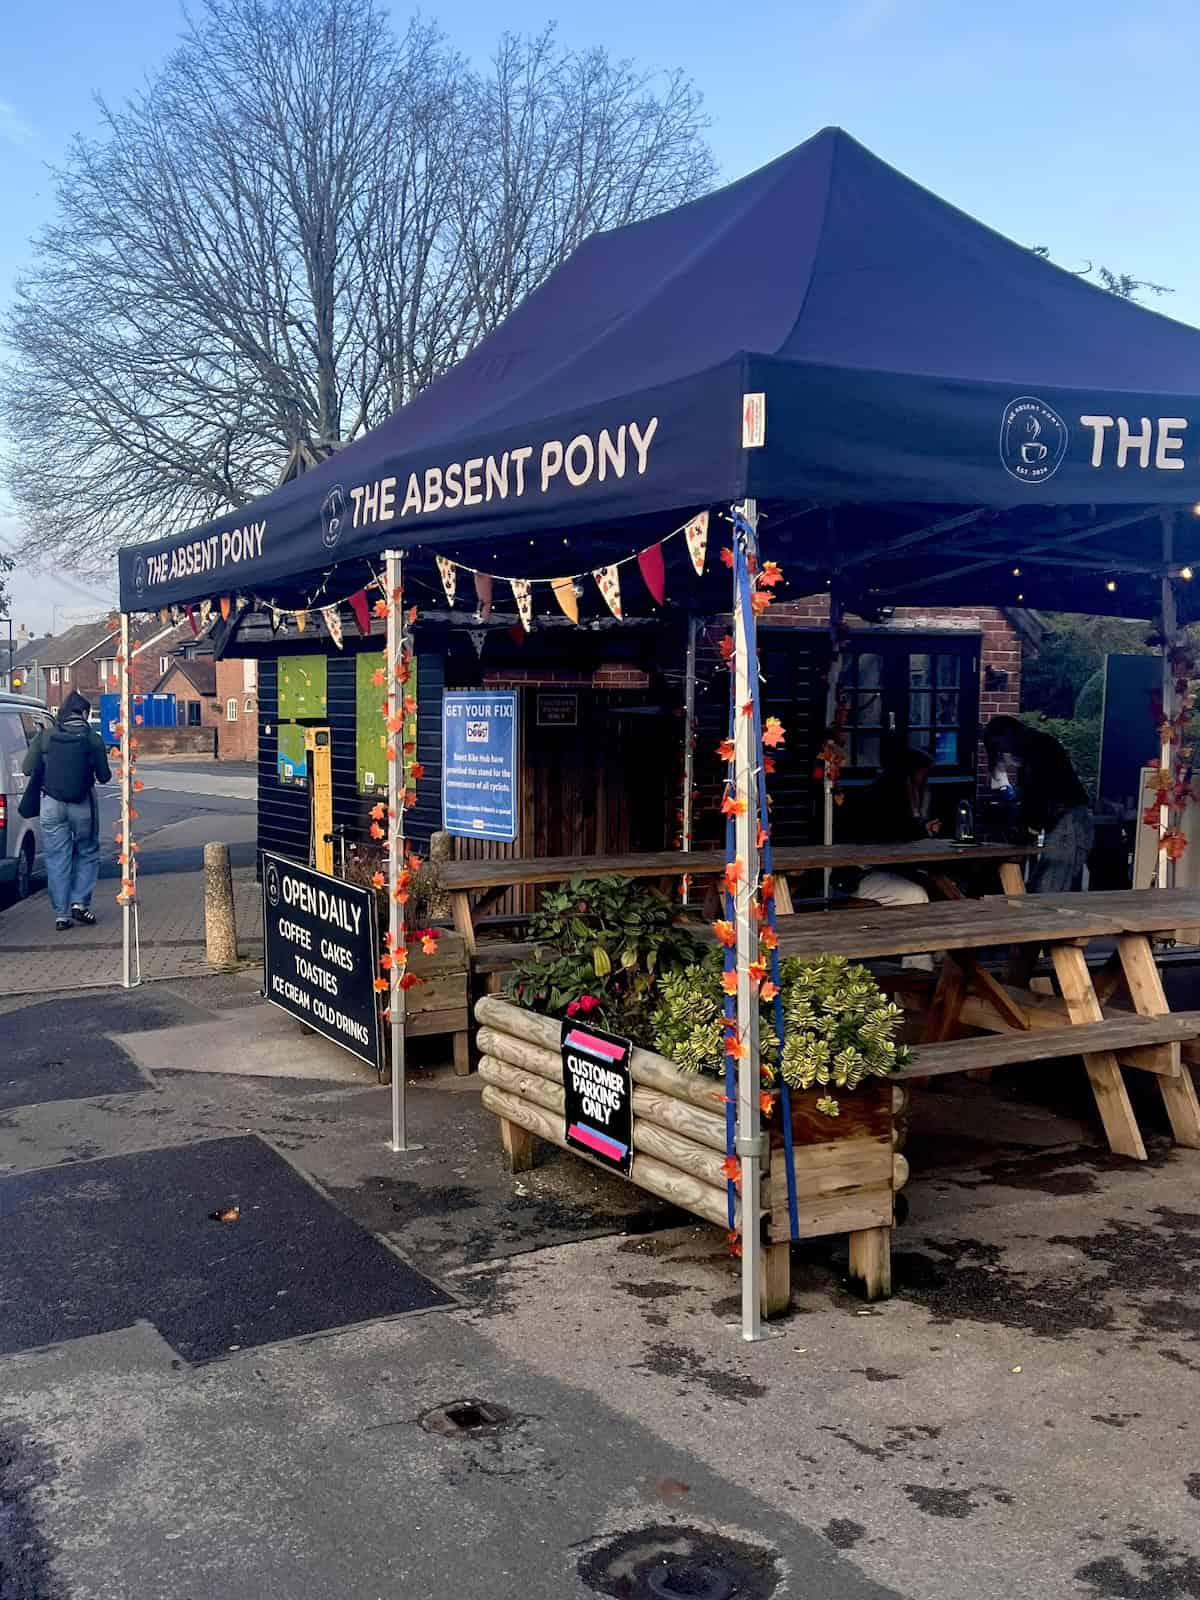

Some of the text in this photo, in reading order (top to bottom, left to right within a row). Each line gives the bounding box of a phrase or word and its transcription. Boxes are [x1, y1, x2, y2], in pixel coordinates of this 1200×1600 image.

[1080, 415, 1188, 470] THE
[350, 476, 397, 528] THE
[401, 446, 534, 517] ABSENT
[541, 416, 659, 492] PONY
[147, 520, 267, 586] THE ABSENT PONY
[446, 703, 512, 717] GET YOUR FIX!
[282, 875, 362, 935] OPEN DAILY
[278, 917, 353, 971] COFFEE CAKES
[294, 955, 338, 996] TOASTIES
[272, 974, 369, 1046] ICE CREAM COLD DRINKS
[567, 1055, 625, 1095] CUSTOMER
[572, 1073, 621, 1111] PARKING
[582, 1096, 612, 1125] ONLY
